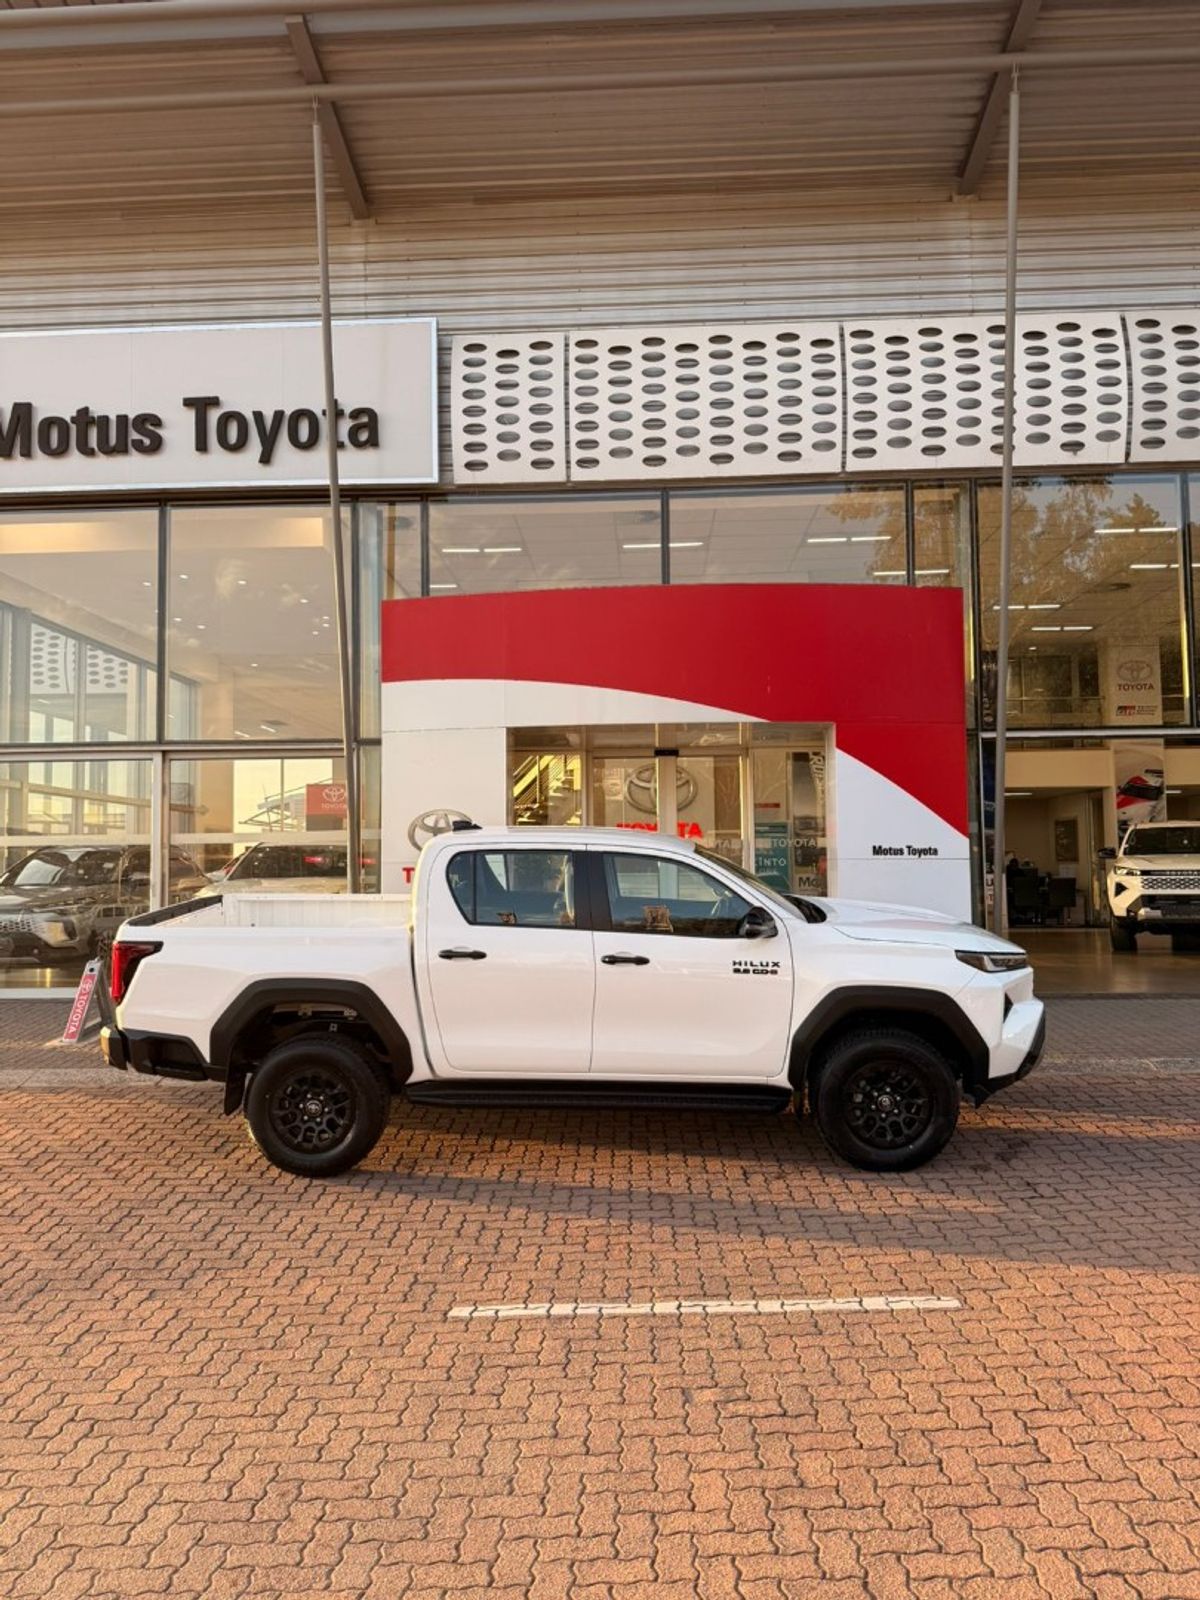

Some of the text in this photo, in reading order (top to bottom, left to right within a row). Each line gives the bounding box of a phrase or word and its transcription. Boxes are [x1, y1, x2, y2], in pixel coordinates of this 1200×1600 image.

[0, 402, 164, 459] Motus
[1117, 682, 1155, 692] TOYOTA
[771, 838, 817, 848] TOYOTA
[872, 845, 938, 858] Motus Toyota
[732, 960, 780, 968] HILUX
[69, 993, 89, 1033] TOYOTA
